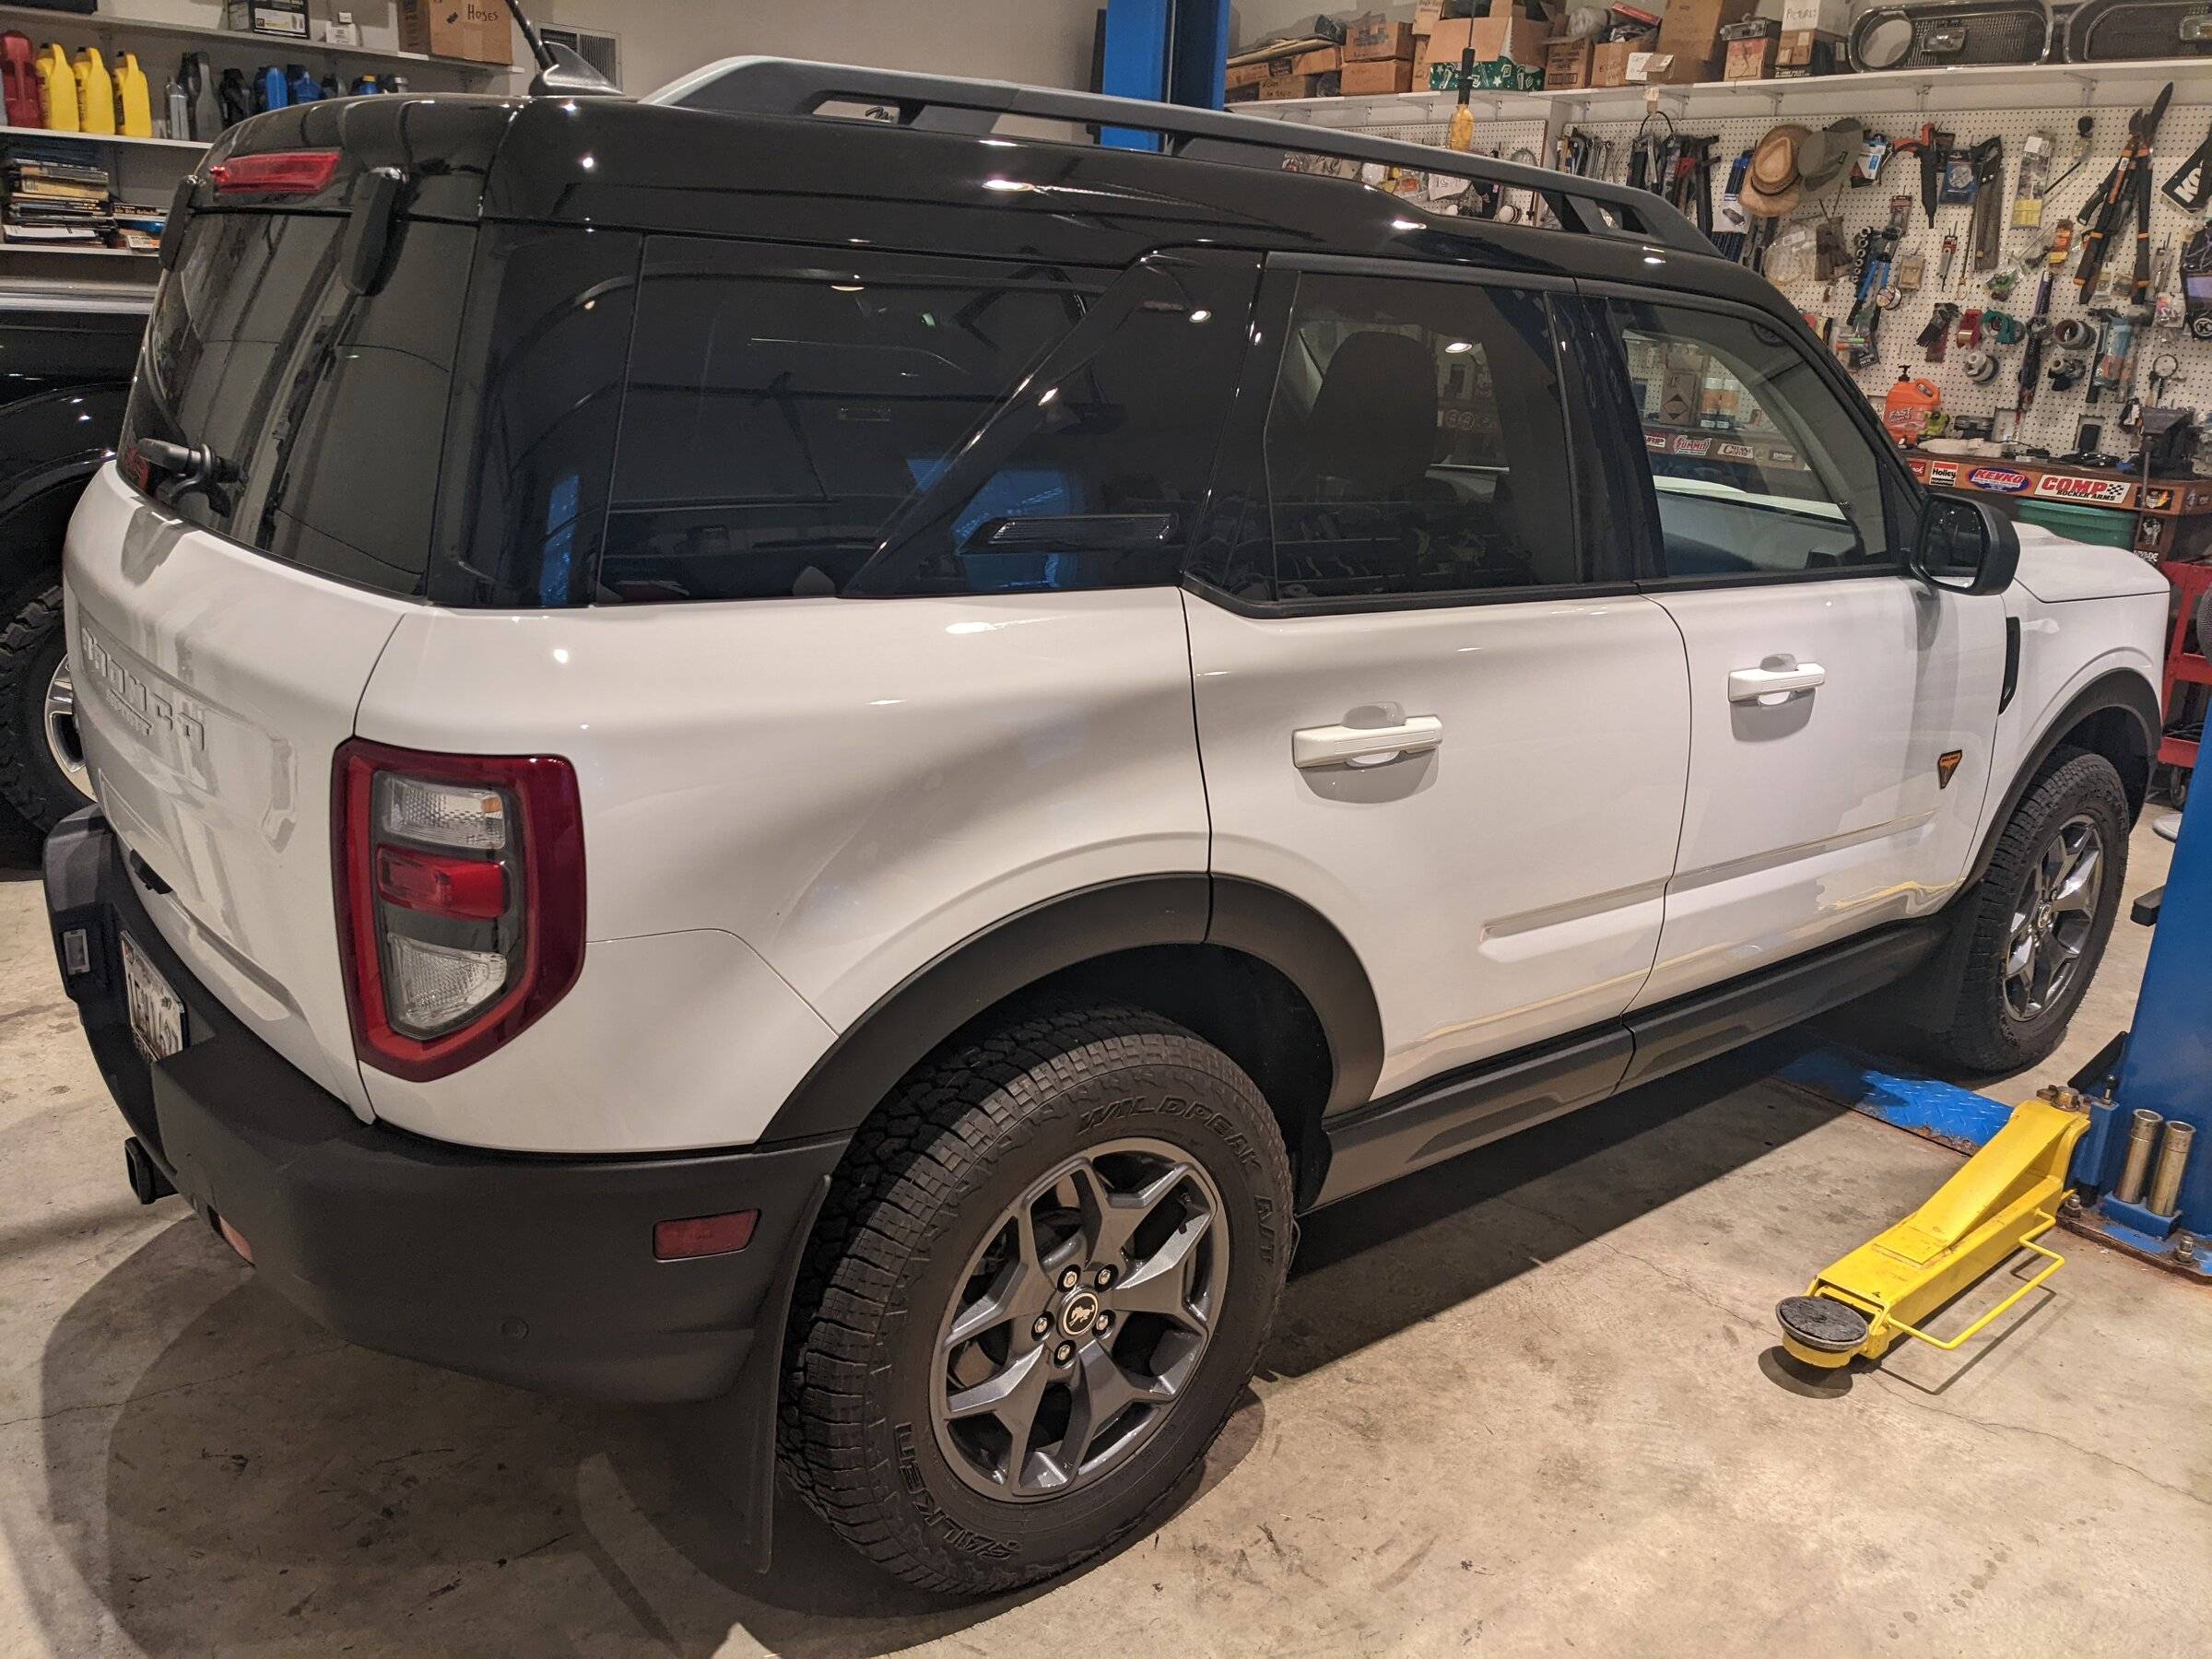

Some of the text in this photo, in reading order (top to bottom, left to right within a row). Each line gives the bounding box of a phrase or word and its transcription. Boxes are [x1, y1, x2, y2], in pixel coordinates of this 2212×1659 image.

[1932, 467, 1956, 478] Holley
[1974, 469, 2026, 484] KEVKO
[2041, 476, 2109, 494] COMP
[2056, 489, 2116, 501] ROCKER ARMS
[82, 627, 206, 751] BRONCO
[1077, 1095, 1263, 1171] WILDPEAK
